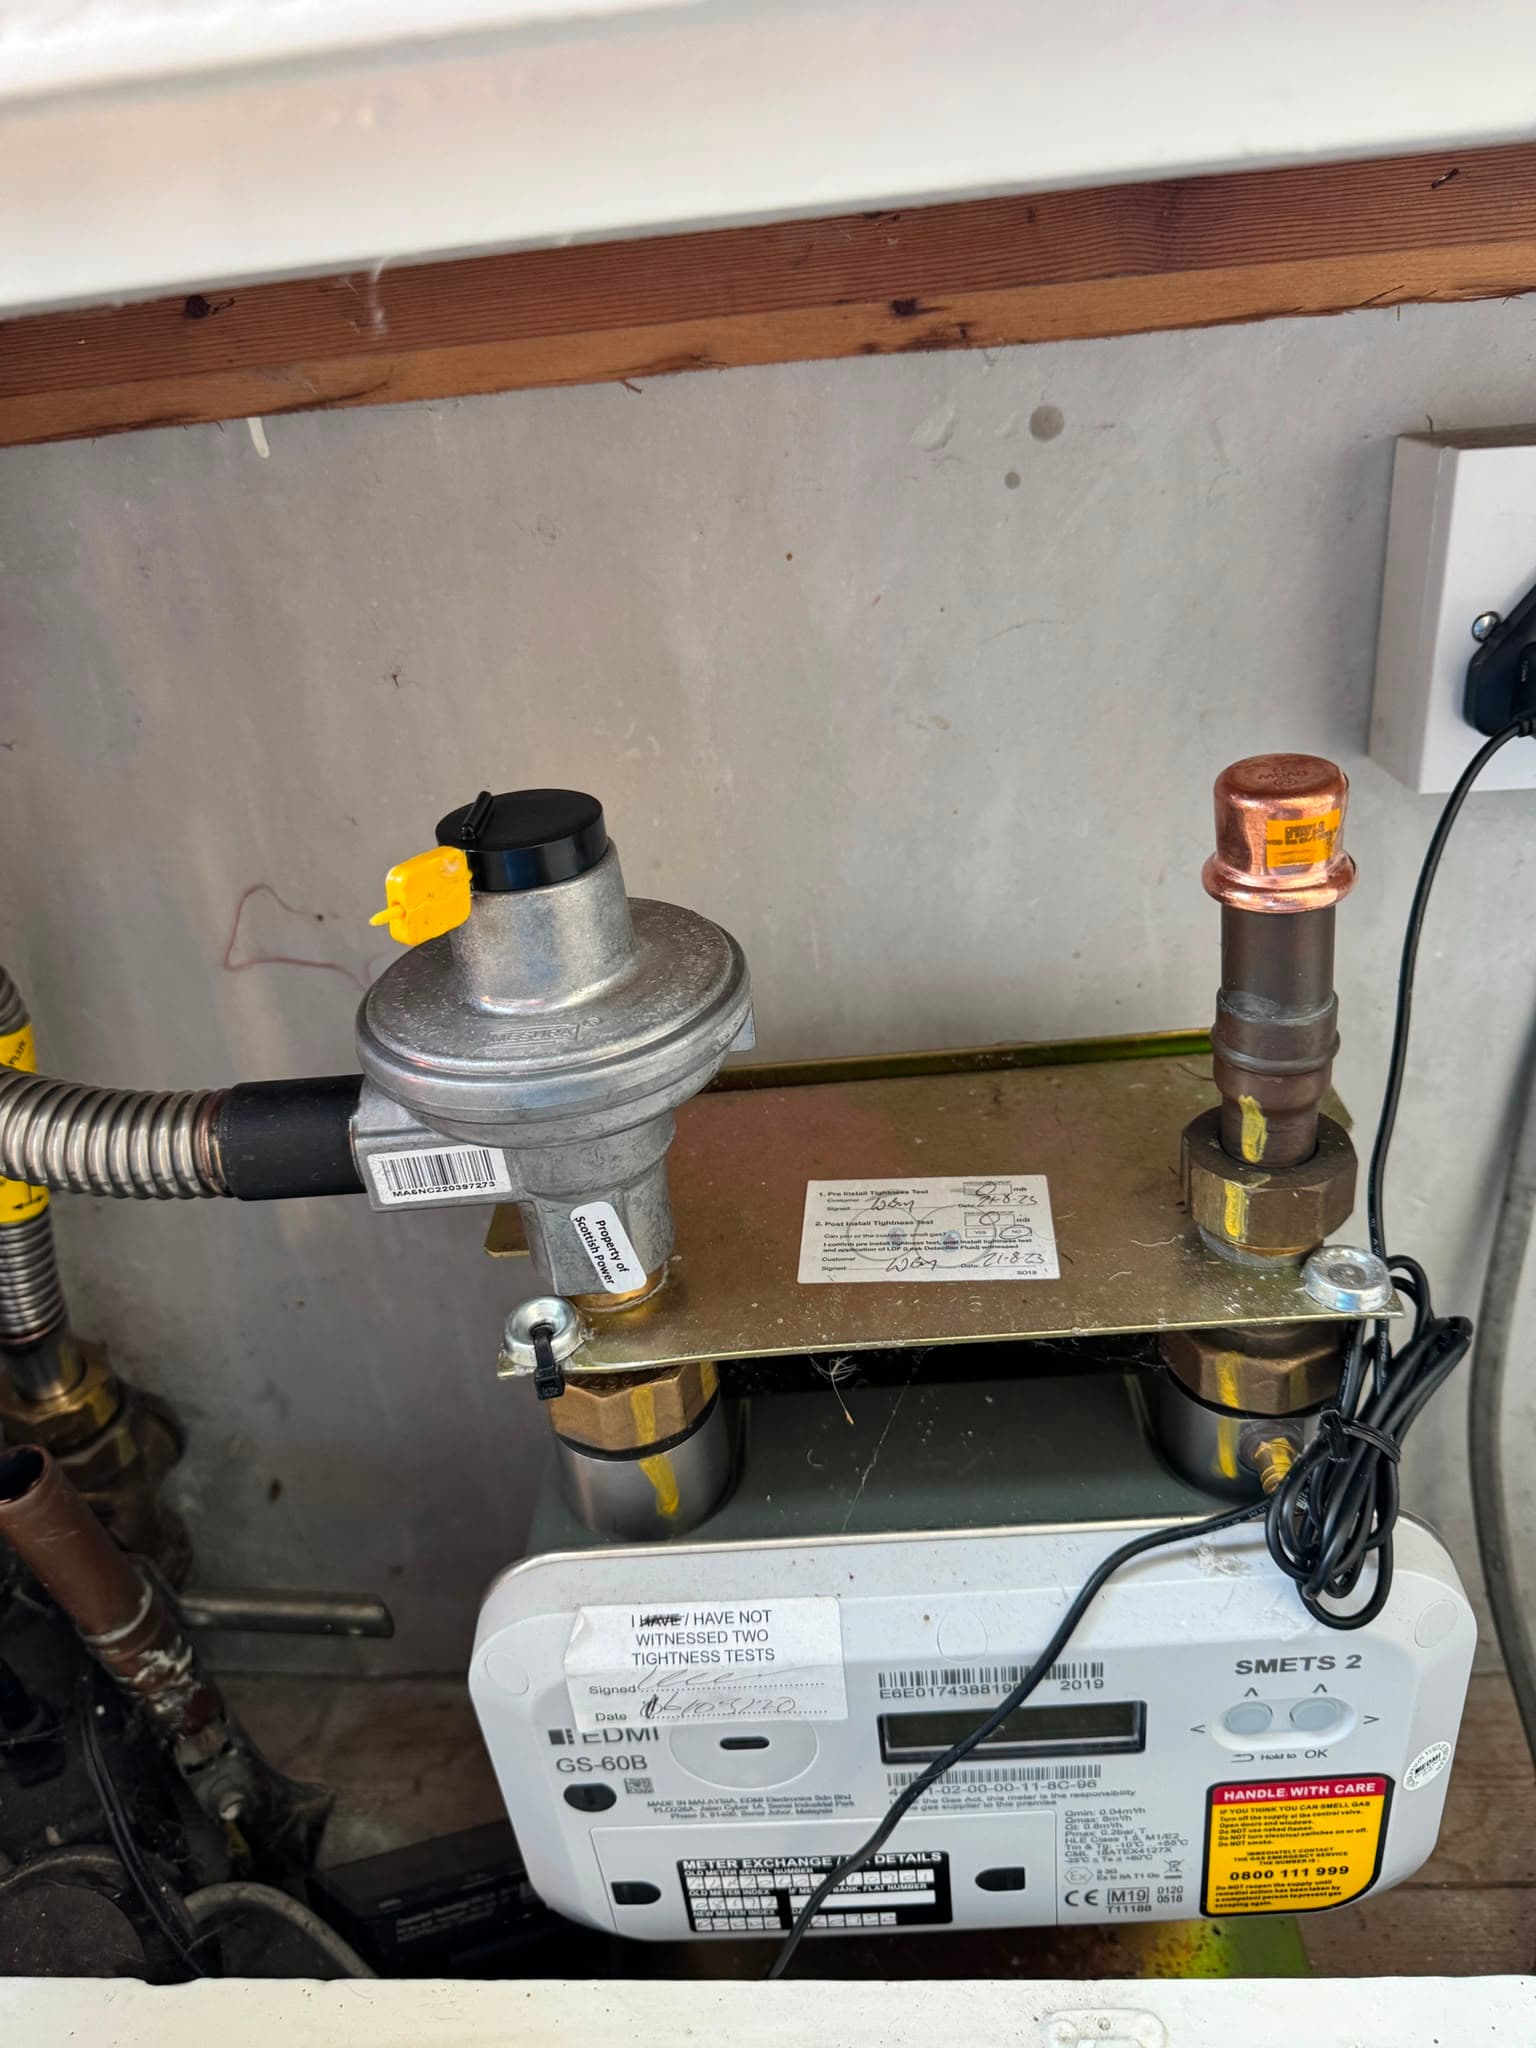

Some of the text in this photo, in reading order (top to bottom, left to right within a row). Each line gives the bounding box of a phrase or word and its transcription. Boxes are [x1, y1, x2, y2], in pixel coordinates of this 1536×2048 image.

[870, 1189, 909, 1198] Tightness
[874, 1220, 914, 1229] Tightness
[574, 1215, 615, 1285] Scottish Power
[596, 1220, 630, 1273] Property of
[631, 1615, 635, 1628] I
[694, 1611, 734, 1626] HAVE
[739, 1610, 772, 1624] NOT
[636, 1629, 769, 1646] WITNESSED TWO
[632, 1648, 775, 1666] TIGHTNESS TESTS
[1235, 1654, 1363, 1675] SMETS 2
[589, 1685, 637, 1697] Signed
[1060, 1678, 1104, 1691] 2019
[595, 1712, 627, 1722] Date
[582, 1727, 659, 1744] EDMI
[1286, 1752, 1297, 1760] to
[1304, 1749, 1328, 1759] OK
[556, 1755, 648, 1773] GS-60B
[1070, 1790, 1136, 1799] responsibility
[1224, 1783, 1376, 1801] HANDLE WITH CARE
[683, 1859, 738, 1869] METER
[742, 1856, 832, 1868] EXCHANGE
[875, 1852, 942, 1864] DETAILS
[1230, 1866, 1349, 1880] 0800 111 999
[863, 1884, 885, 1892] FLAT
[887, 1882, 927, 1890] NUMBER
[1157, 1886, 1184, 1894] 0120
[1111, 1890, 1146, 1902] M19
